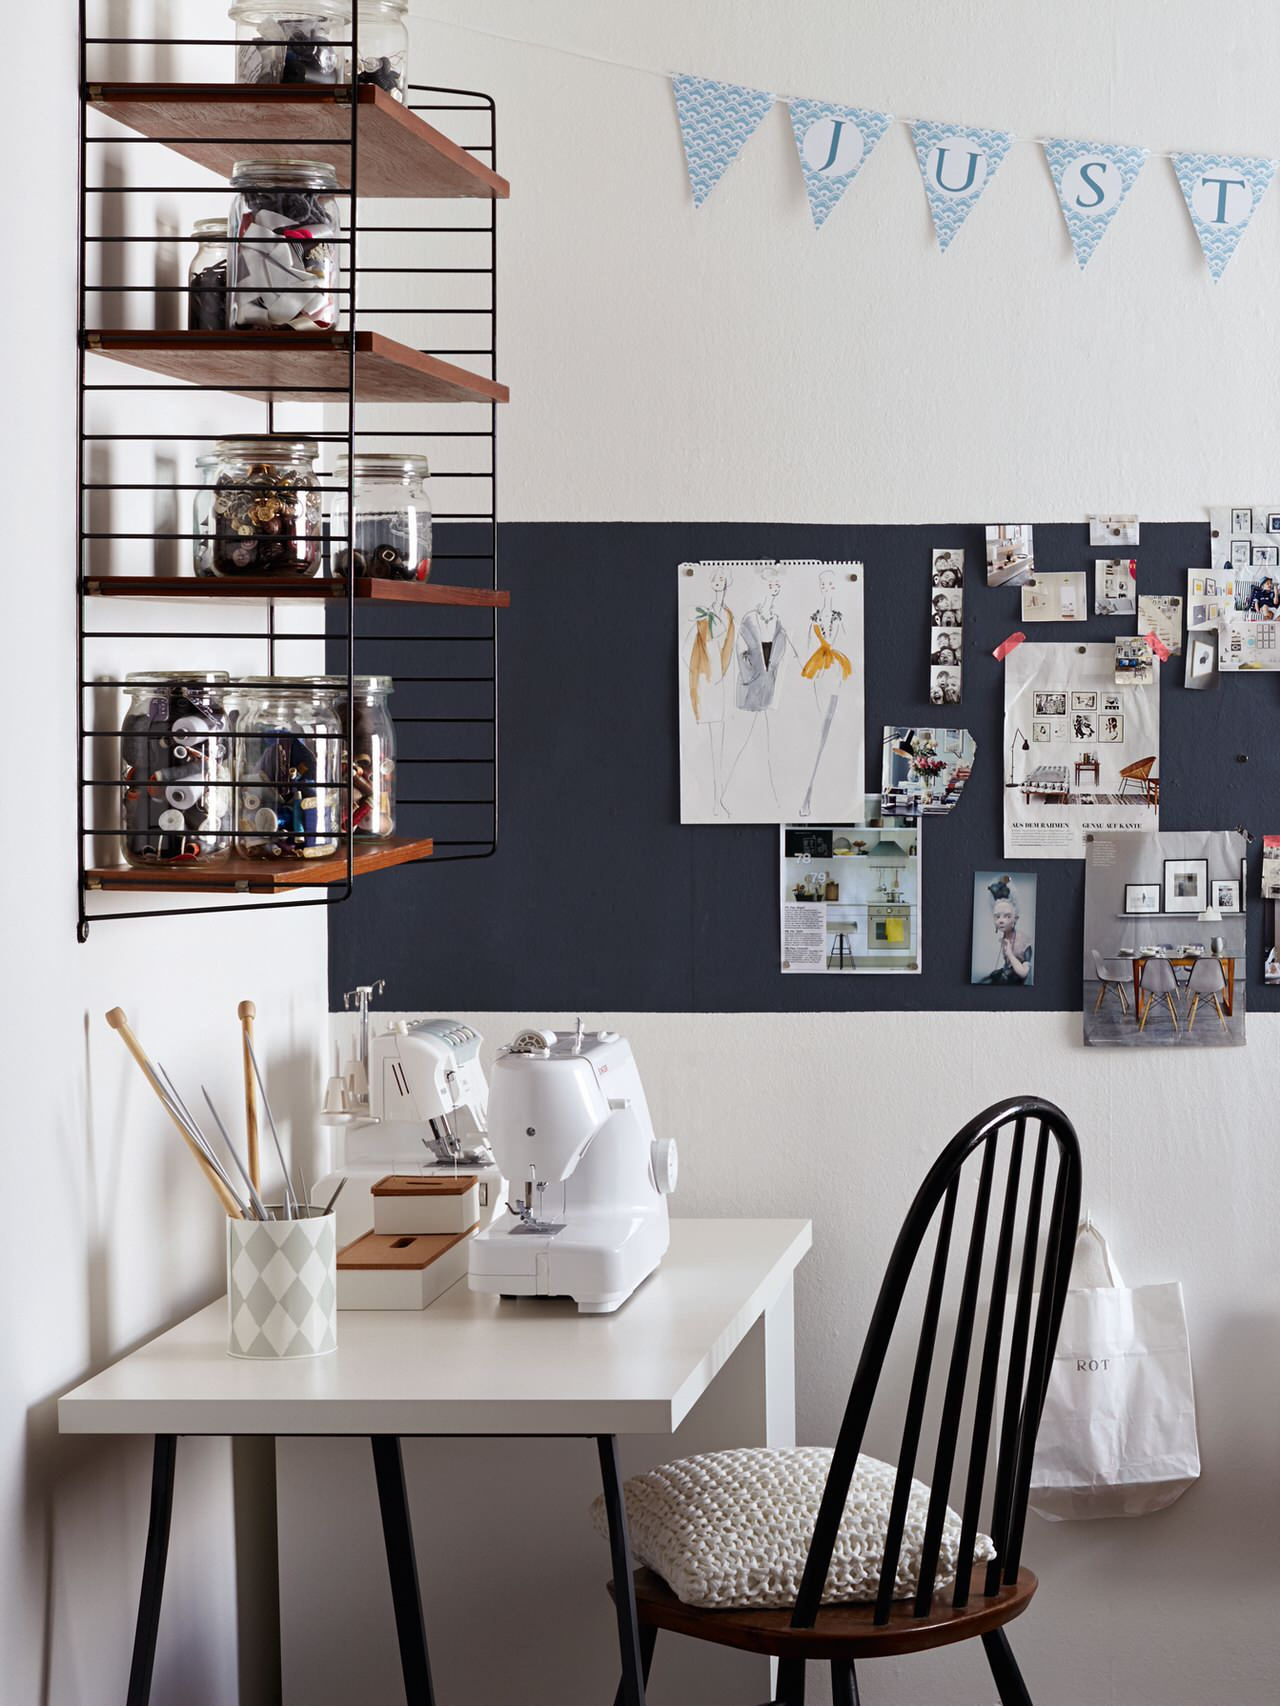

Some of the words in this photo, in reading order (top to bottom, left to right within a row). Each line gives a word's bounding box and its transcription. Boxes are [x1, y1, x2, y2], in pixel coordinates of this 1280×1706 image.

[818, 119, 1246, 224] JUST
[794, 852, 811, 864] 78
[808, 872, 826, 883] 79
[1077, 1359, 1110, 1372] ROT
